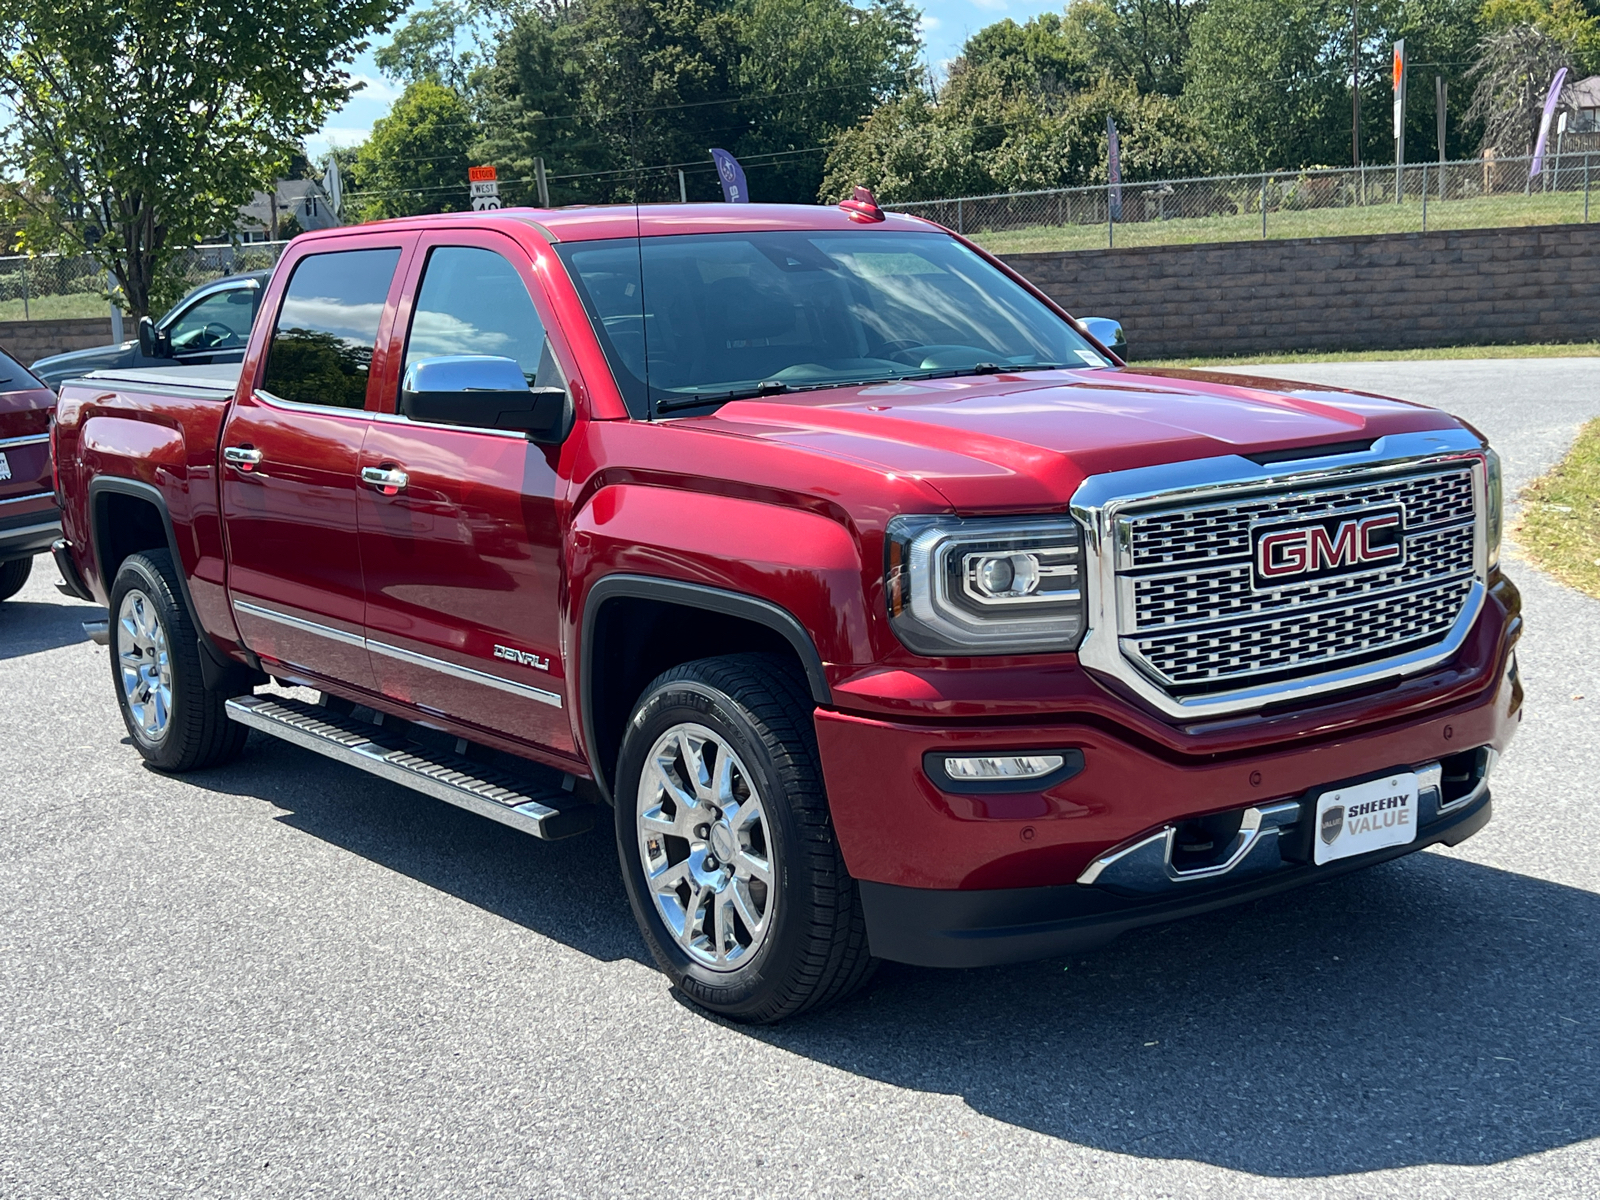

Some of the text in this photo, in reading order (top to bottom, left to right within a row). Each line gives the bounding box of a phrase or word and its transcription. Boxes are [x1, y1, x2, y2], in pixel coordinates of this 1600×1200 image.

[471, 169, 493, 179] DETOUR
[474, 184, 494, 193] WEST
[1258, 512, 1399, 578] GMC
[493, 644, 550, 671] DENALI
[1348, 794, 1410, 818] SHEEHY
[1348, 808, 1410, 835] VALUE
